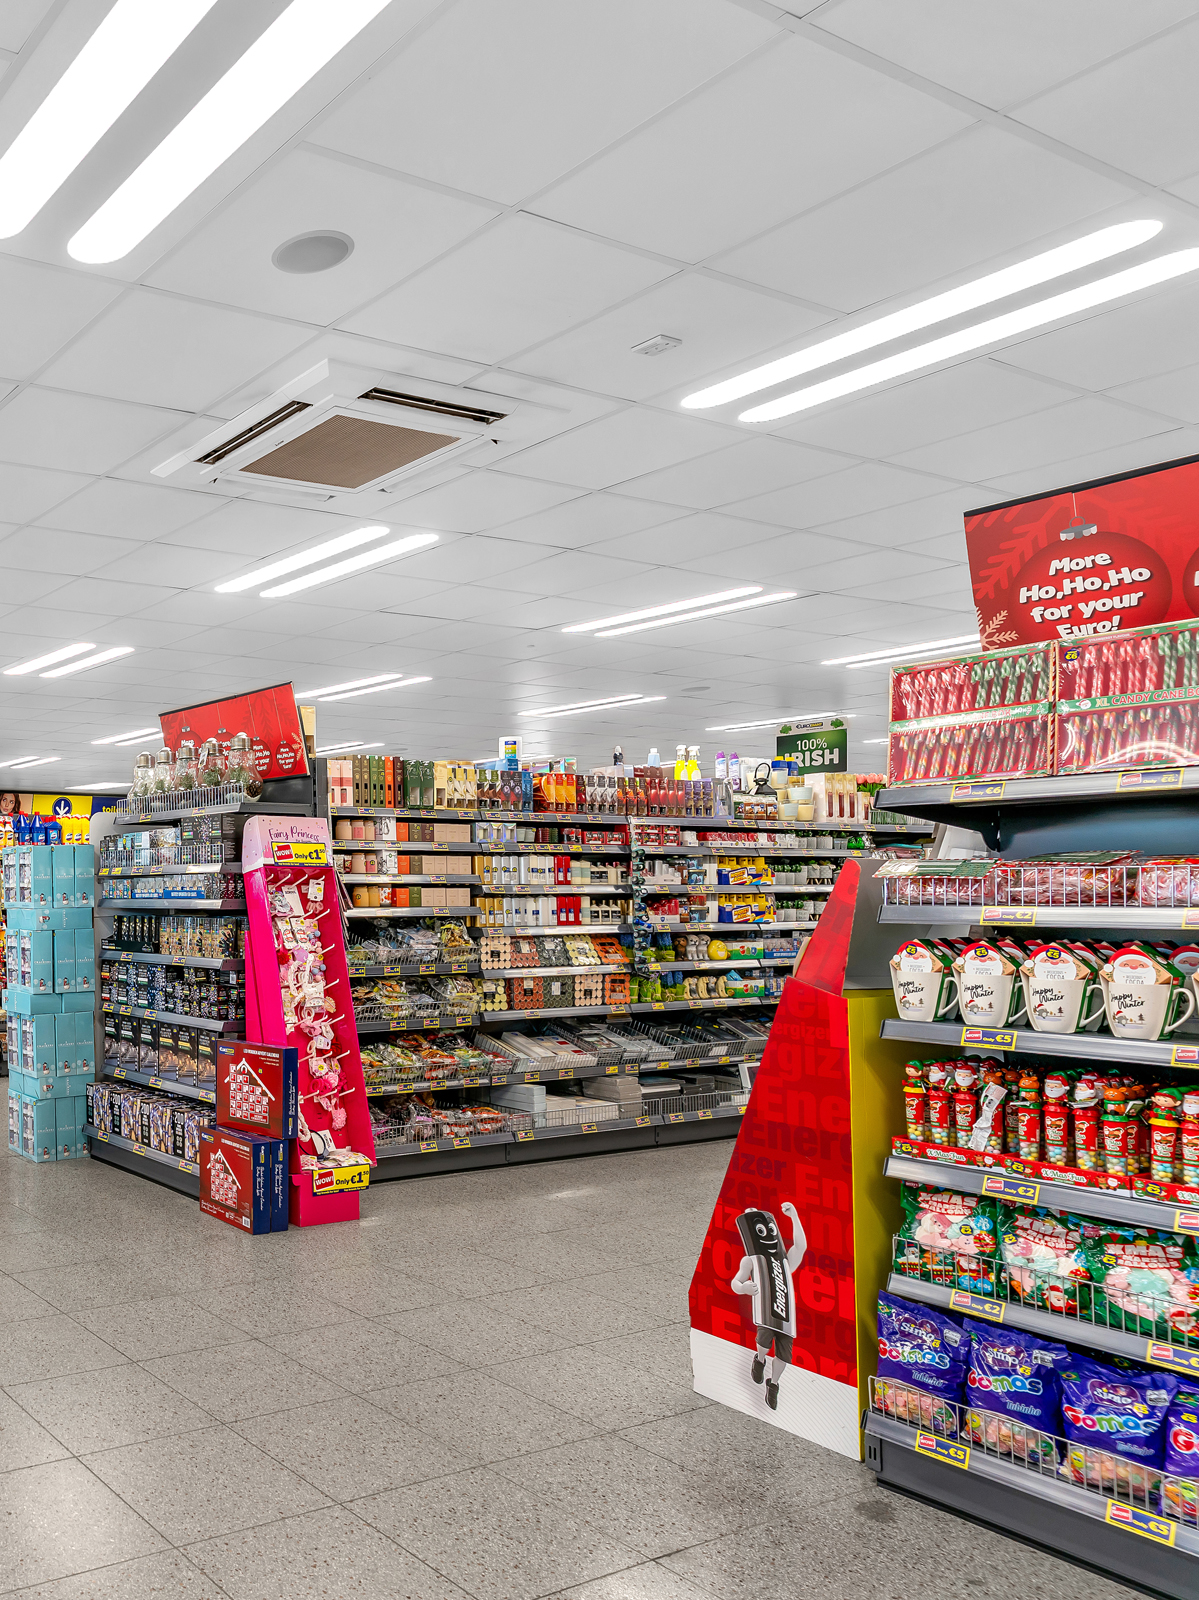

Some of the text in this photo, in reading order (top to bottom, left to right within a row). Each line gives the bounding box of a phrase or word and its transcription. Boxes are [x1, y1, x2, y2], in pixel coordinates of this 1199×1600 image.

[1049, 553, 1112, 576] More
[1019, 567, 1151, 603] Ho,Ho,Ho
[1030, 592, 1143, 622] for your
[1056, 615, 1120, 639] Euro!
[1095, 687, 1199, 707] XL CANDY CANE BO
[796, 738, 827, 750] 100%
[986, 786, 1001, 794] €6
[269, 826, 320, 843] Fairy Princess
[1016, 911, 1032, 919] €2
[903, 986, 925, 995] Winter
[964, 984, 984, 993] Happy
[970, 990, 995, 999] Winter
[1032, 988, 1054, 996] Happy
[1039, 994, 1065, 1003] Winter
[1111, 993, 1133, 1002] Happy
[1118, 1000, 1145, 1009] Winter
[996, 1035, 1012, 1043] €5
[949, 1152, 966, 1161] Fun
[316, 1176, 334, 1186] WOW!
[1069, 1174, 1086, 1183] Fun
[919, 1191, 978, 1207] XMAS
[1018, 1187, 1035, 1197] €2
[1015, 1215, 1081, 1242] XMAS
[1105, 1244, 1183, 1259] XMAS
[773, 1257, 786, 1320] Energizer
[984, 1303, 1000, 1314] €2
[901, 1322, 934, 1340] Simo
[878, 1337, 950, 1369] Gomas
[987, 1348, 1018, 1365] Simo
[968, 1366, 1042, 1395] Gomas
[1094, 1388, 1132, 1404] Simo
[1007, 1401, 1042, 1416] Tubinho
[1063, 1404, 1160, 1436] Gomas
[936, 1447, 948, 1455] Only
[949, 1448, 965, 1460] €5
[1148, 1521, 1170, 1535] €5
